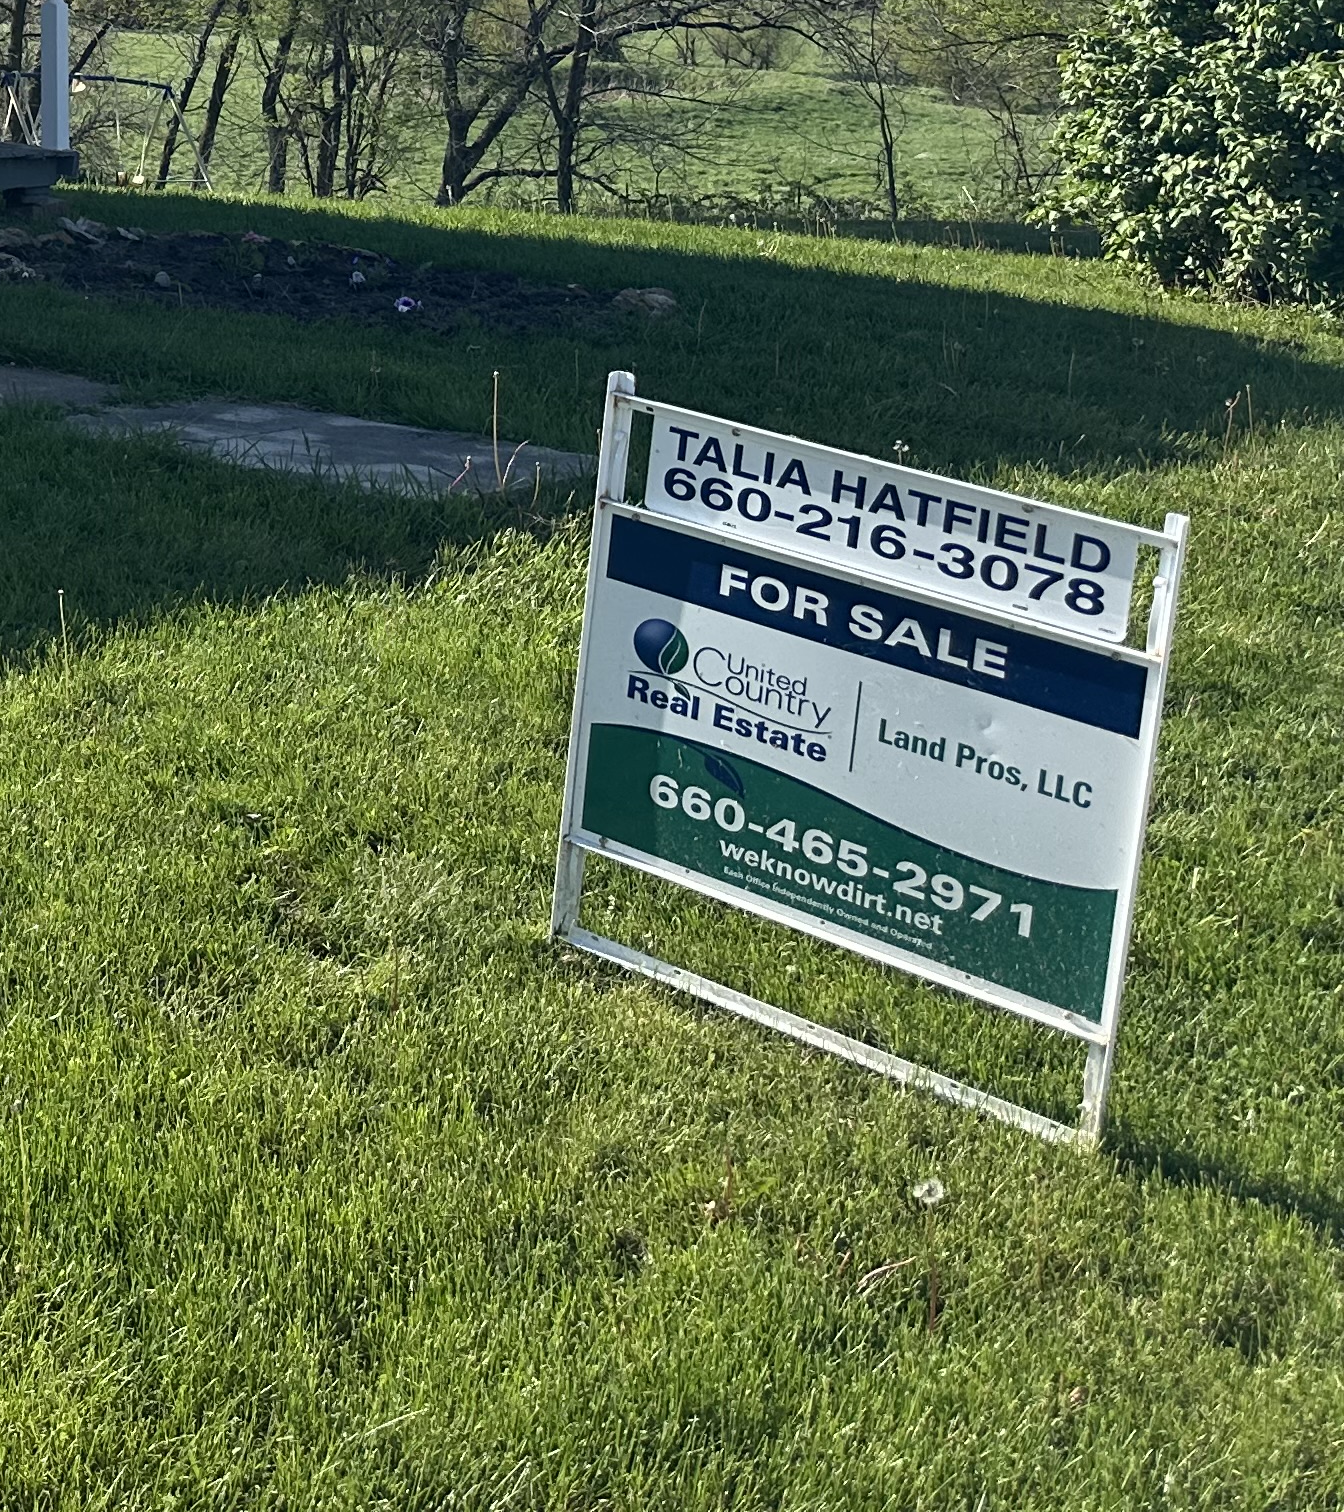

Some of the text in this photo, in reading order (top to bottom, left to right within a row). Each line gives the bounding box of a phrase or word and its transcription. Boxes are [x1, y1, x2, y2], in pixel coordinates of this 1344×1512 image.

[663, 467, 1105, 616] 660-216-3078
[669, 426, 1111, 574] TALIA HATFIELD
[719, 563, 1008, 679] FOR SALE
[627, 674, 827, 762] Real Estate
[693, 646, 832, 729] Country
[727, 652, 808, 697] United
[878, 717, 1093, 809] Land Pros, LLC
[649, 774, 1034, 938] 660-465-2971
[719, 839, 944, 936] weknowdirt.net
[745, 874, 771, 890] Office
[772, 882, 835, 915] Independently
[871, 922, 889, 933] and
